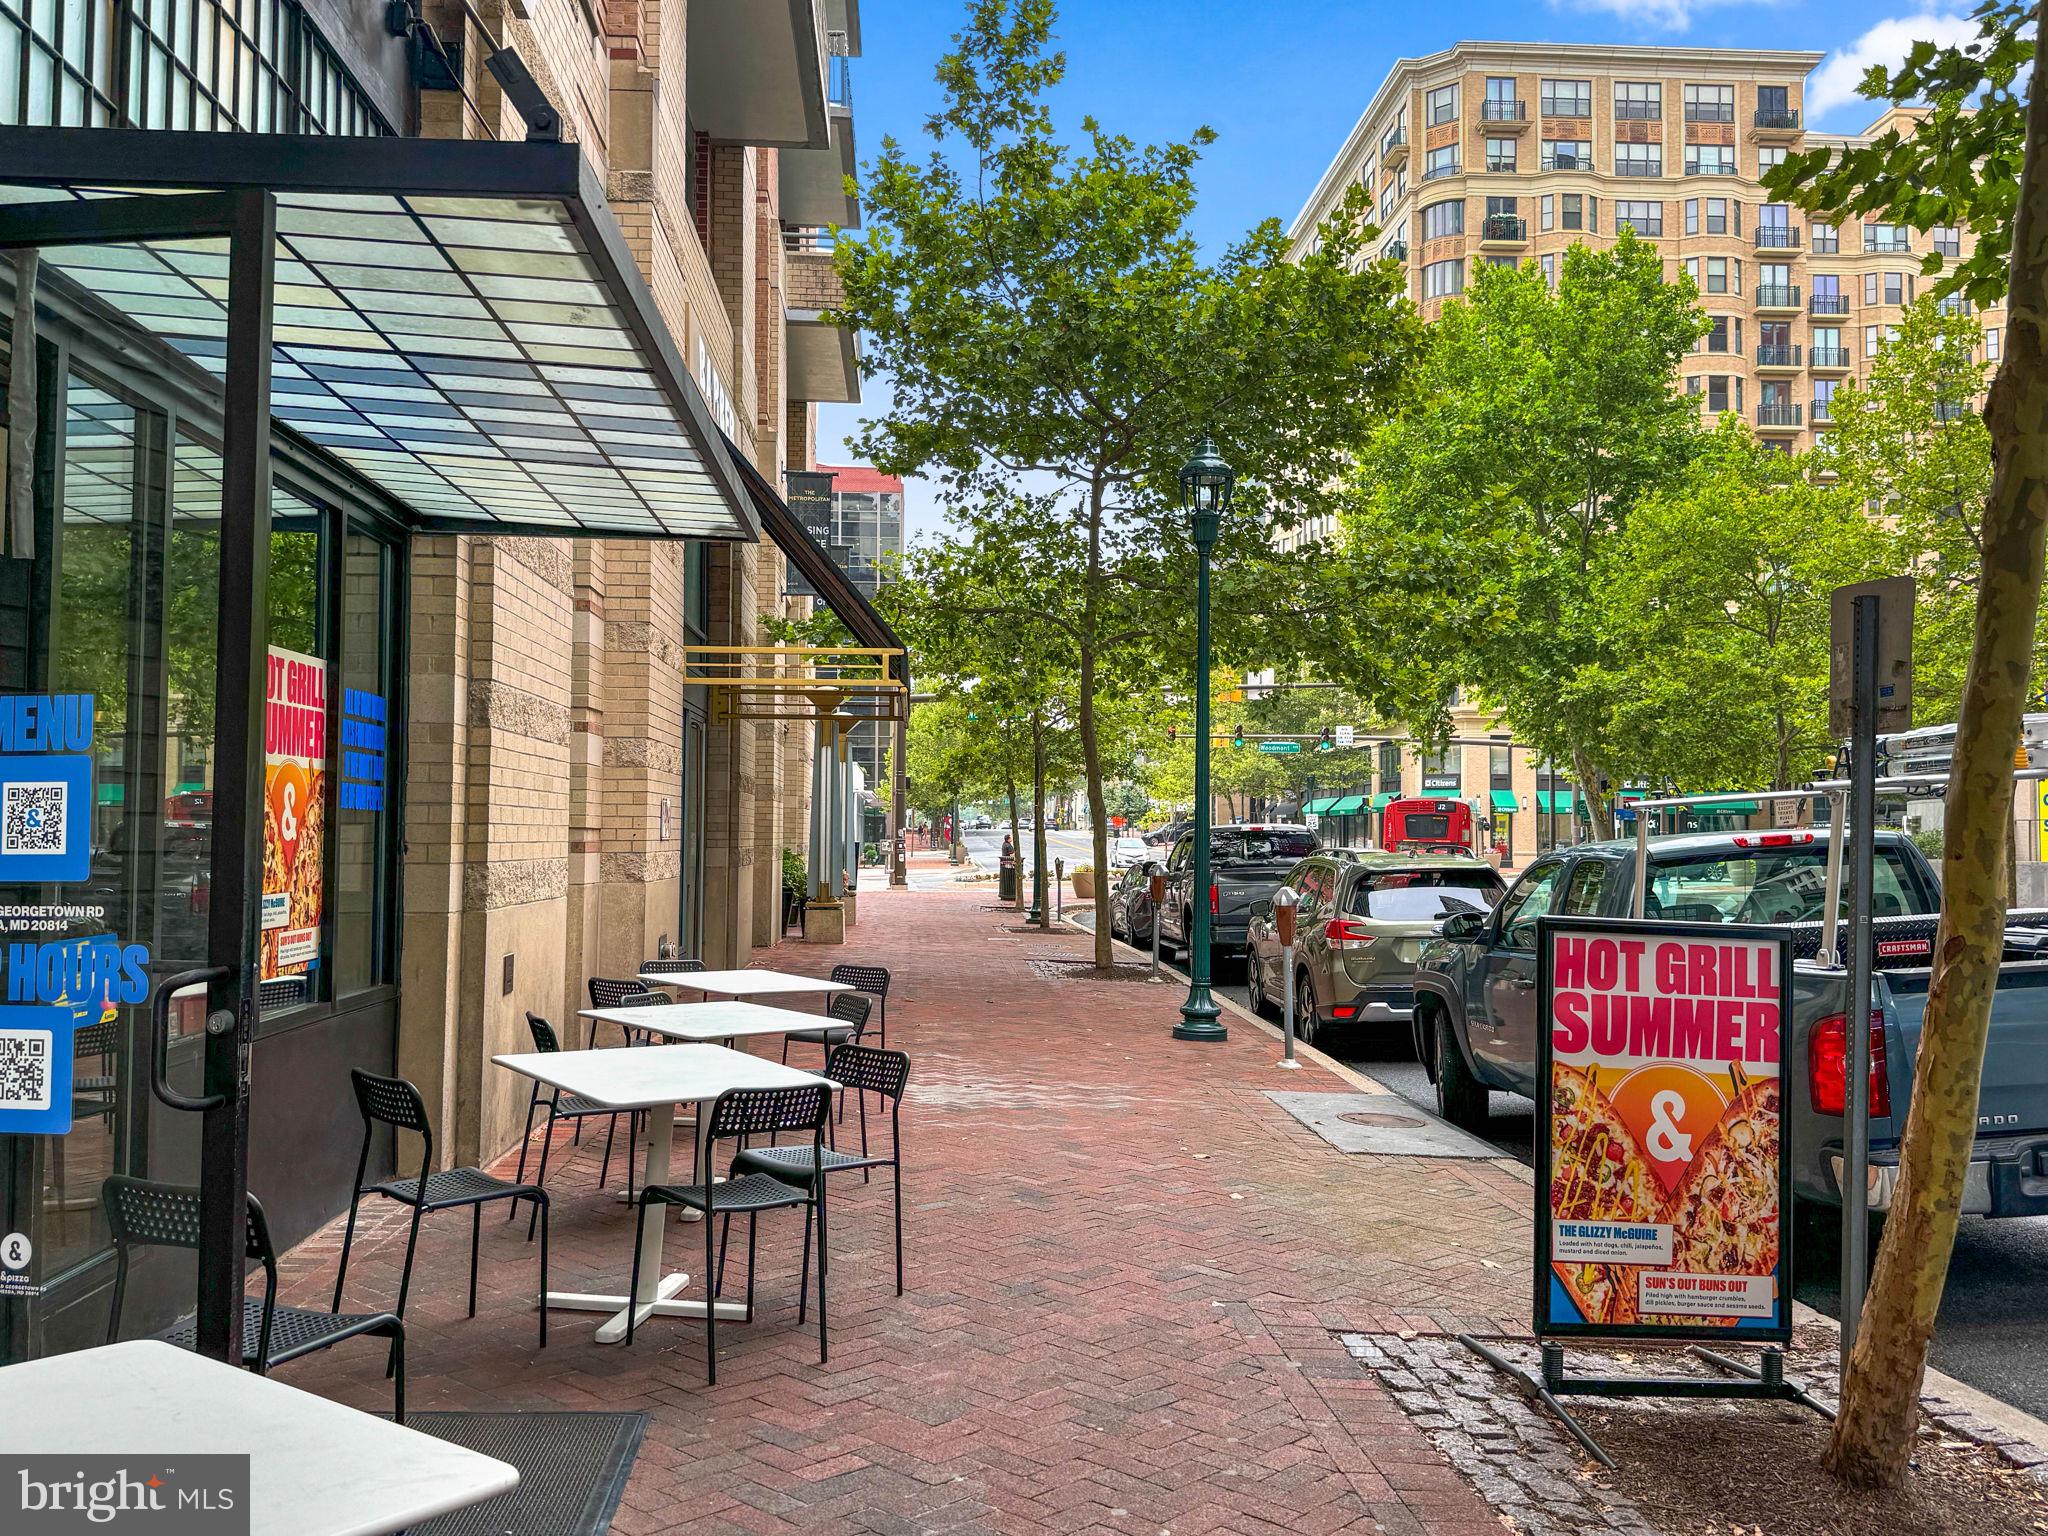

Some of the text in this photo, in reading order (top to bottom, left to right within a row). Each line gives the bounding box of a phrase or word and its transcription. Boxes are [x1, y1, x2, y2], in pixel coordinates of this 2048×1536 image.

[807, 526, 830, 535] SING
[267, 654, 285, 701] OT
[287, 660, 325, 709] GRILL
[266, 701, 325, 760] UMMER
[1260, 743, 1290, 751] Woodmont
[1432, 778, 1457, 787] Citizens
[86, 905, 105, 917] RD
[10, 919, 30, 931] MD
[31, 919, 69, 931] 20814
[1881, 942, 1928, 953] CRAFTSMAN
[7, 943, 150, 1005] HOURS
[1554, 937, 1780, 999] HOT GRILL
[1552, 991, 1780, 1064] SUMMER
[1979, 1114, 2019, 1125] ADO
[1559, 1225, 1658, 1241] THE GLIZZY McGUIRE
[0, 1270, 30, 1284] &pizza
[1645, 1276, 1748, 1293] SUN'S OUT BUNS OUT
[1687, 1293, 1718, 1301] hamburger
